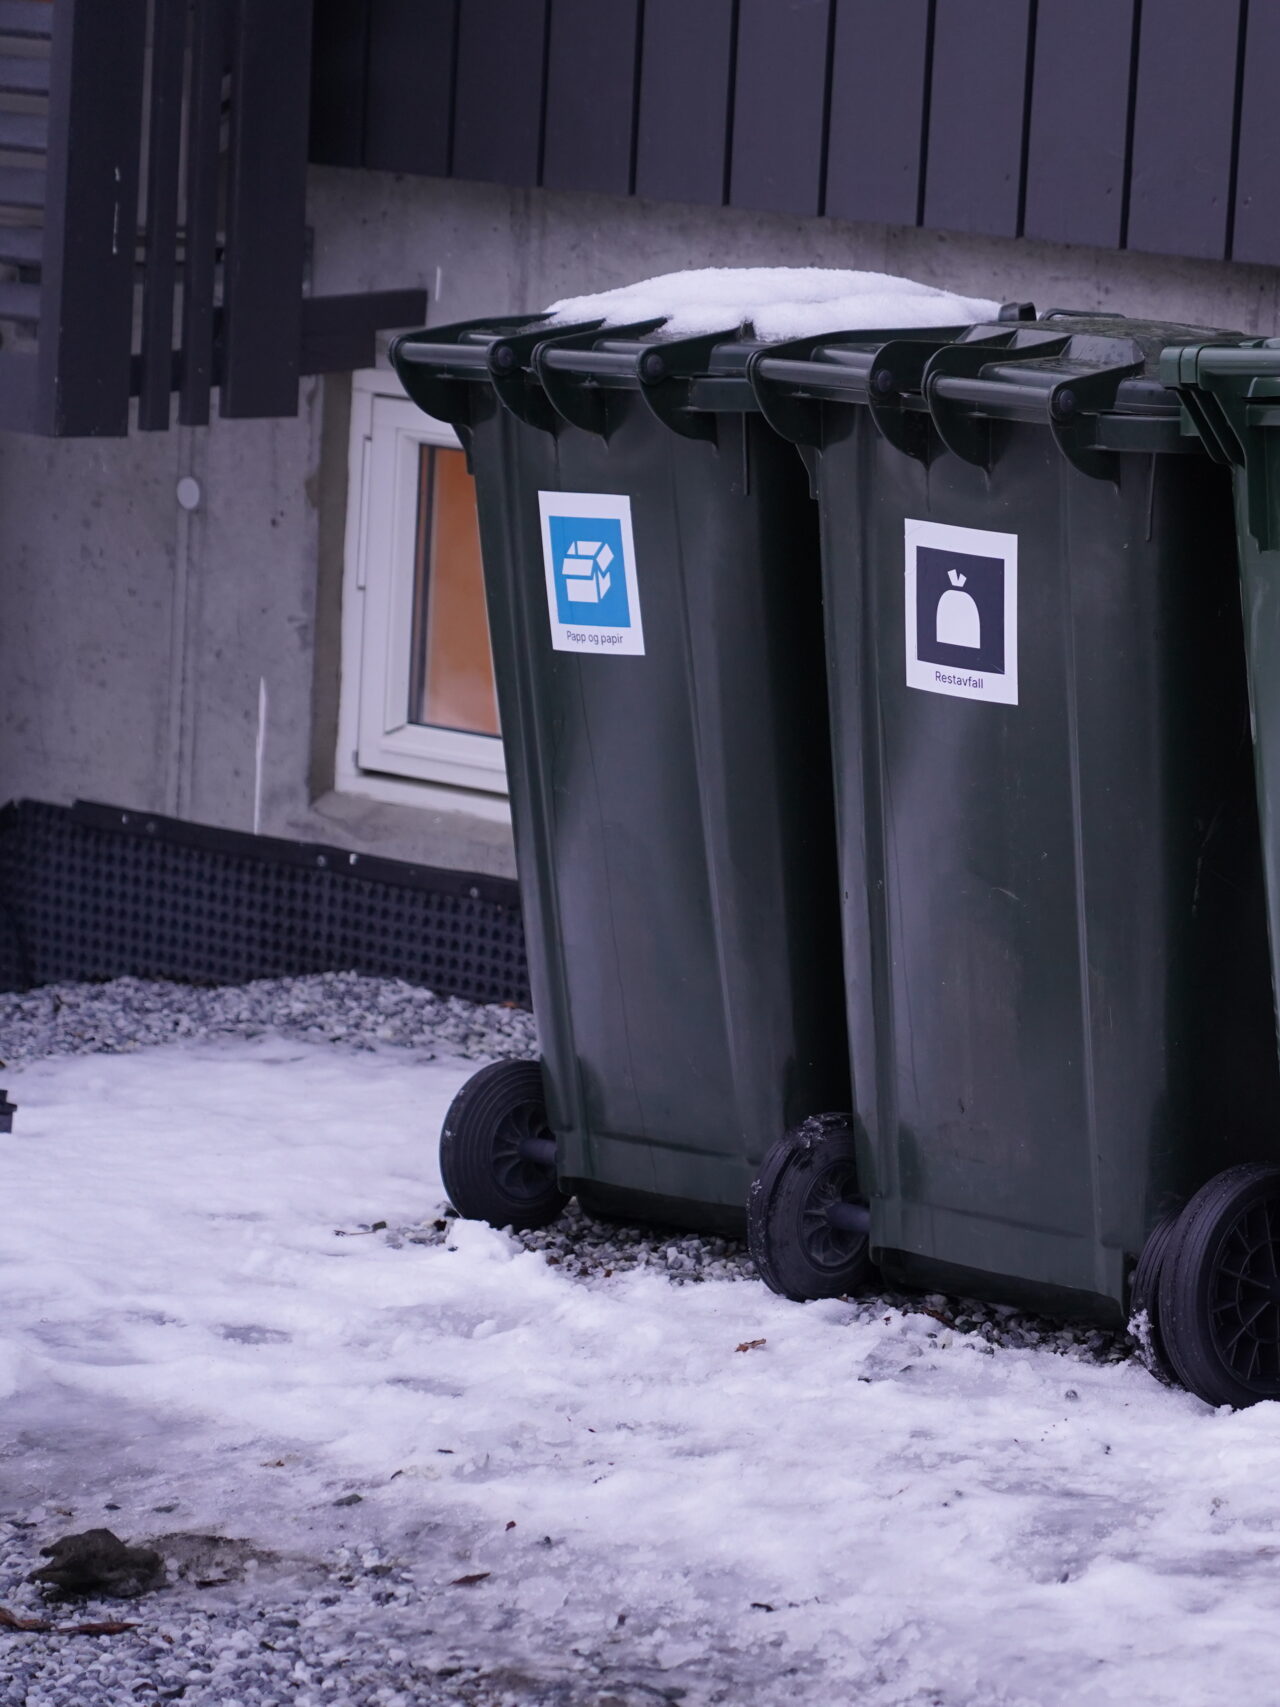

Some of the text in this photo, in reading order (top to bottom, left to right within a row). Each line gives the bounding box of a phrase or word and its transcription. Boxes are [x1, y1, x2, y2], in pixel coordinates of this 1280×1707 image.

[566, 630, 624, 646] Papp og papir
[935, 670, 984, 689] Restavfall
